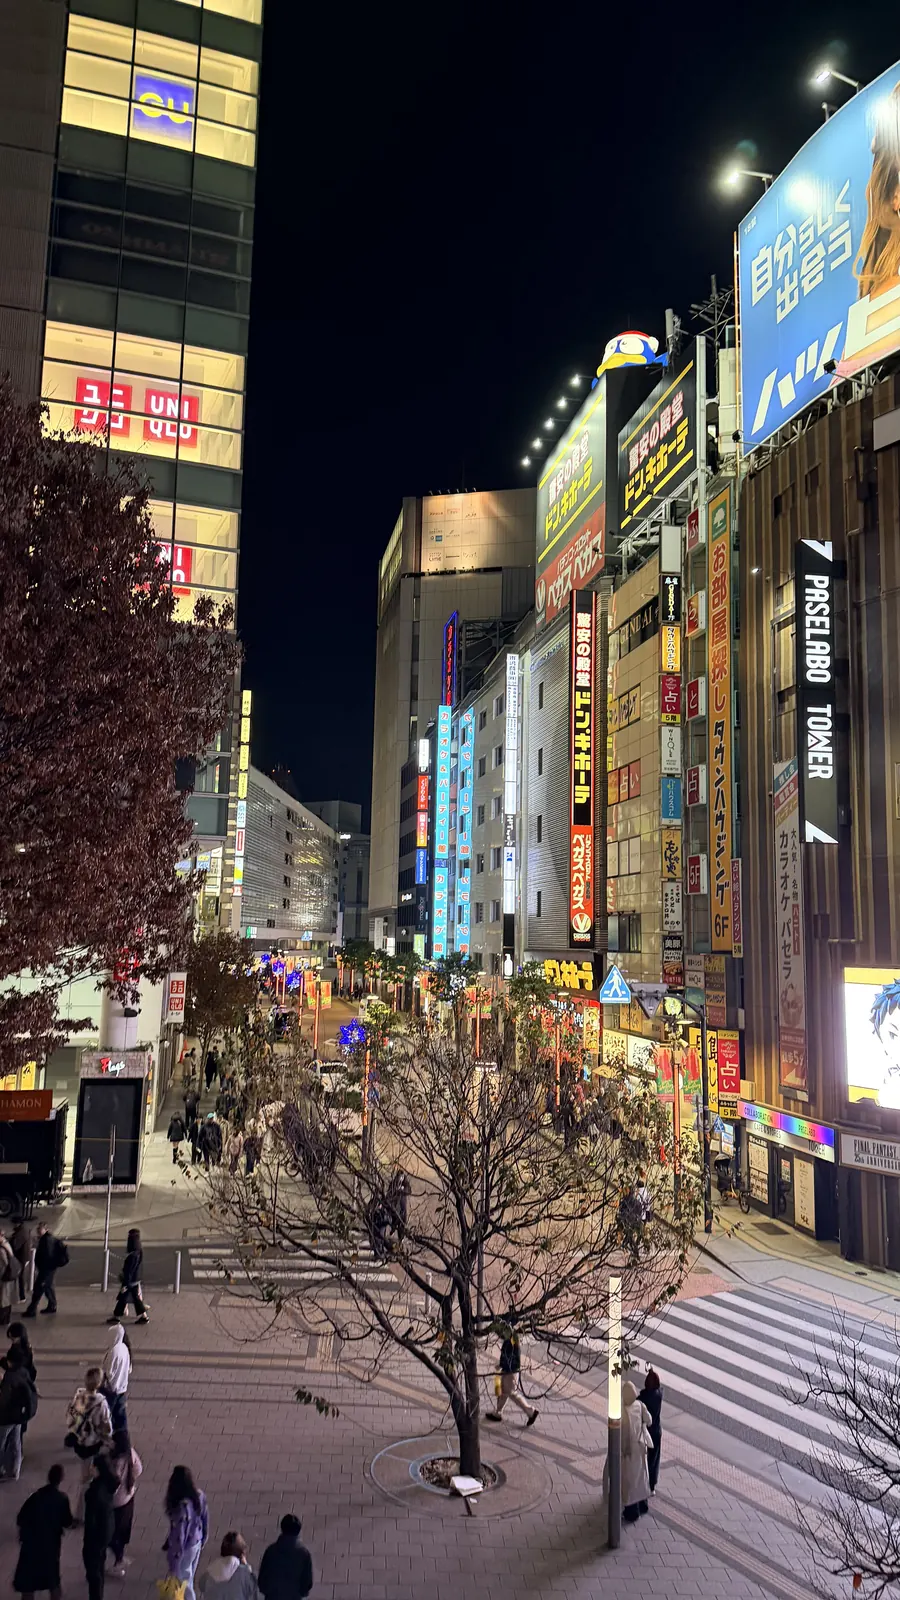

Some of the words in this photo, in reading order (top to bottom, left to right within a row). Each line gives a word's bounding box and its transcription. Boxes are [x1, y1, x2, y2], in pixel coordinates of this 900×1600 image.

[138, 92, 191, 124] GU
[752, 179, 850, 307] 自分らしく
[777, 220, 852, 324] 出会う
[151, 396, 189, 418] UNI
[150, 418, 192, 439] QLO
[629, 390, 683, 476] 驚安の殿堂
[712, 542, 727, 709] お部屋探し
[805, 574, 831, 683] PASELABO
[576, 612, 591, 687] 驚安の殿堂
[665, 690, 678, 712] 占い
[689, 690, 698, 709] と
[807, 704, 833, 779] TOWER
[620, 773, 639, 793] 占い
[714, 720, 729, 906] タウンハウジング
[666, 831, 677, 839] 2F
[690, 865, 700, 885] 5F
[779, 831, 790, 911] カラオケ
[434, 874, 445, 952] カラオケ館
[714, 914, 728, 937] 6F
[792, 905, 800, 952] ハニトー
[781, 918, 791, 979] パセラ
[100, 1057, 125, 1077] Flags
[720, 1060, 739, 1089] 占い
[723, 1109, 737, 1117] 5階
[744, 1106, 774, 1123] COLLABORATION
[753, 1122, 763, 1133] CAFE
[798, 1124, 816, 1138] PASELABO
[808, 1140, 826, 1156] TOWER
[854, 1139, 870, 1153] FINAL
[872, 1142, 896, 1158] FANTASY
